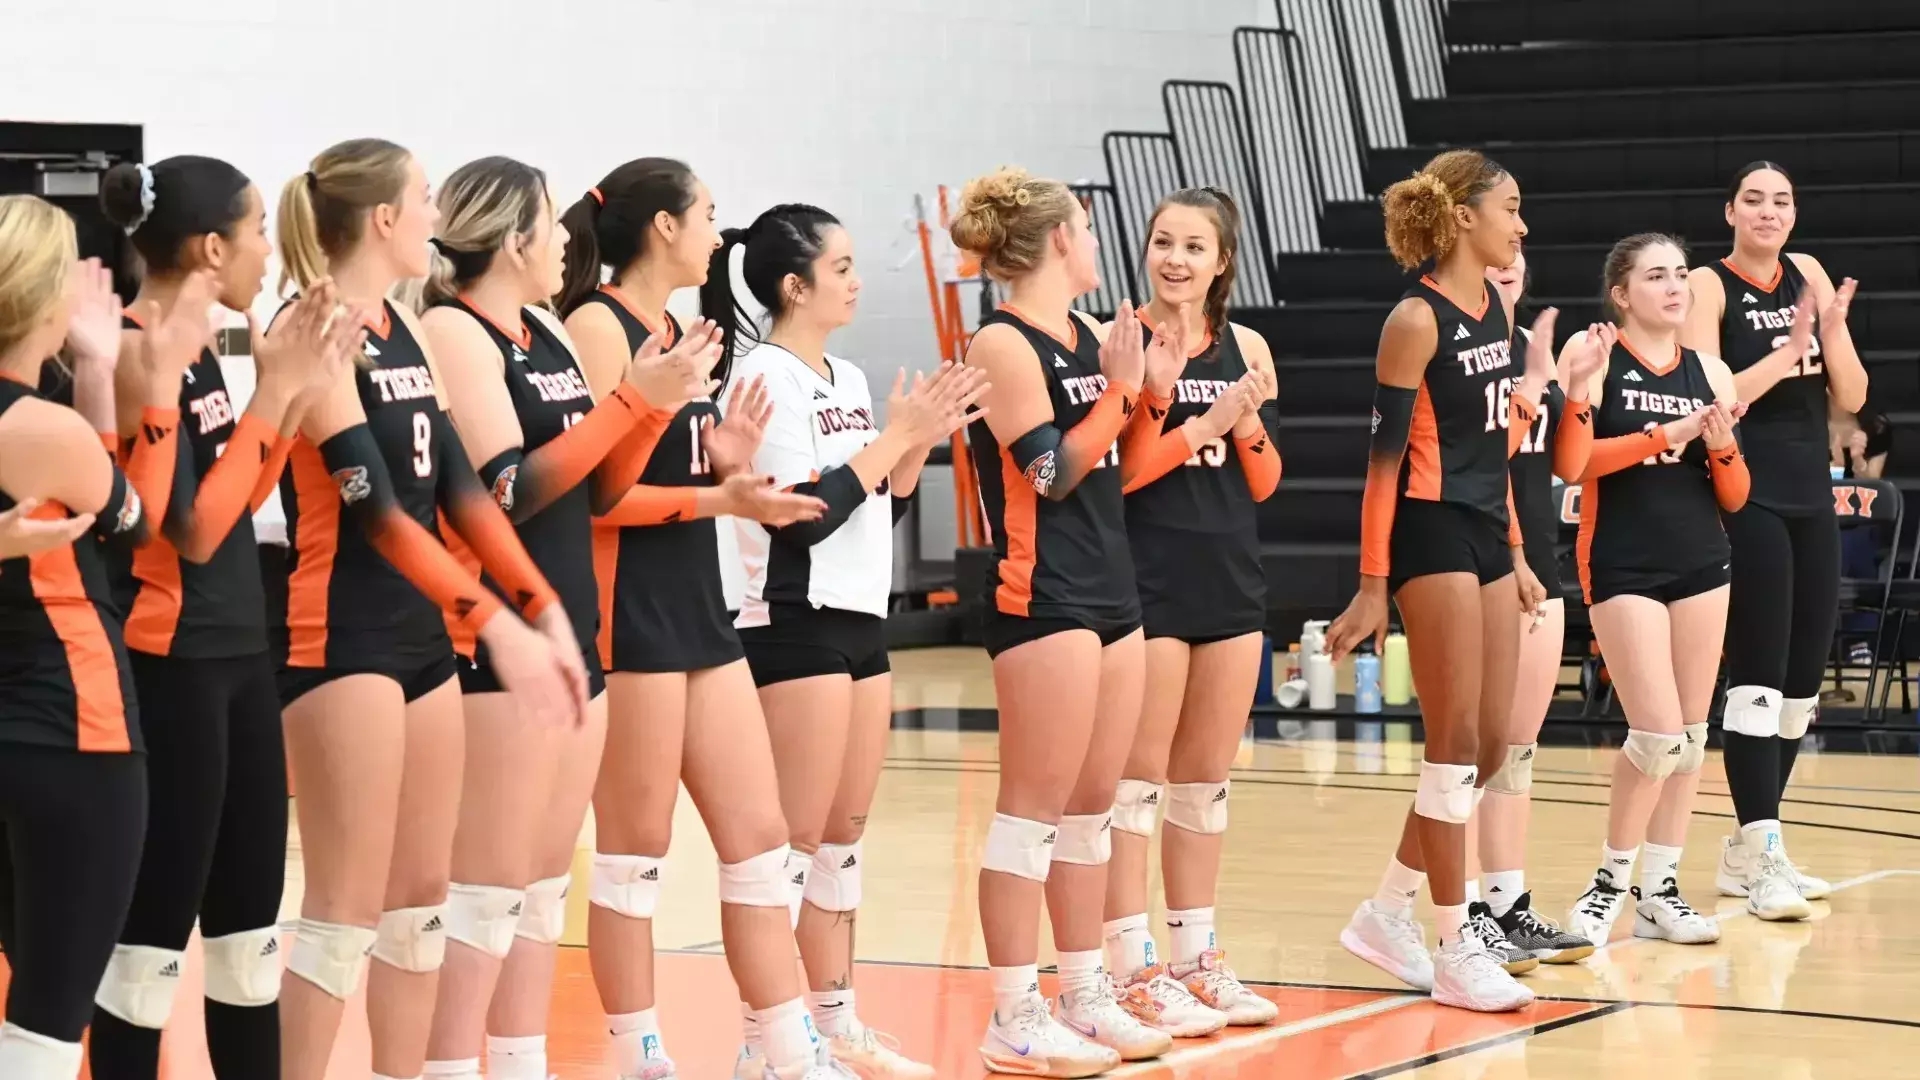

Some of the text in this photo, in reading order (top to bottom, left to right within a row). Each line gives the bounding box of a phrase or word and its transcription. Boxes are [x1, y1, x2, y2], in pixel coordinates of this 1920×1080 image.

[1745, 305, 1815, 330] TIGE
[371, 365, 436, 402] TIGERS
[1484, 377, 1512, 432] 16
[412, 411, 432, 478] 9
